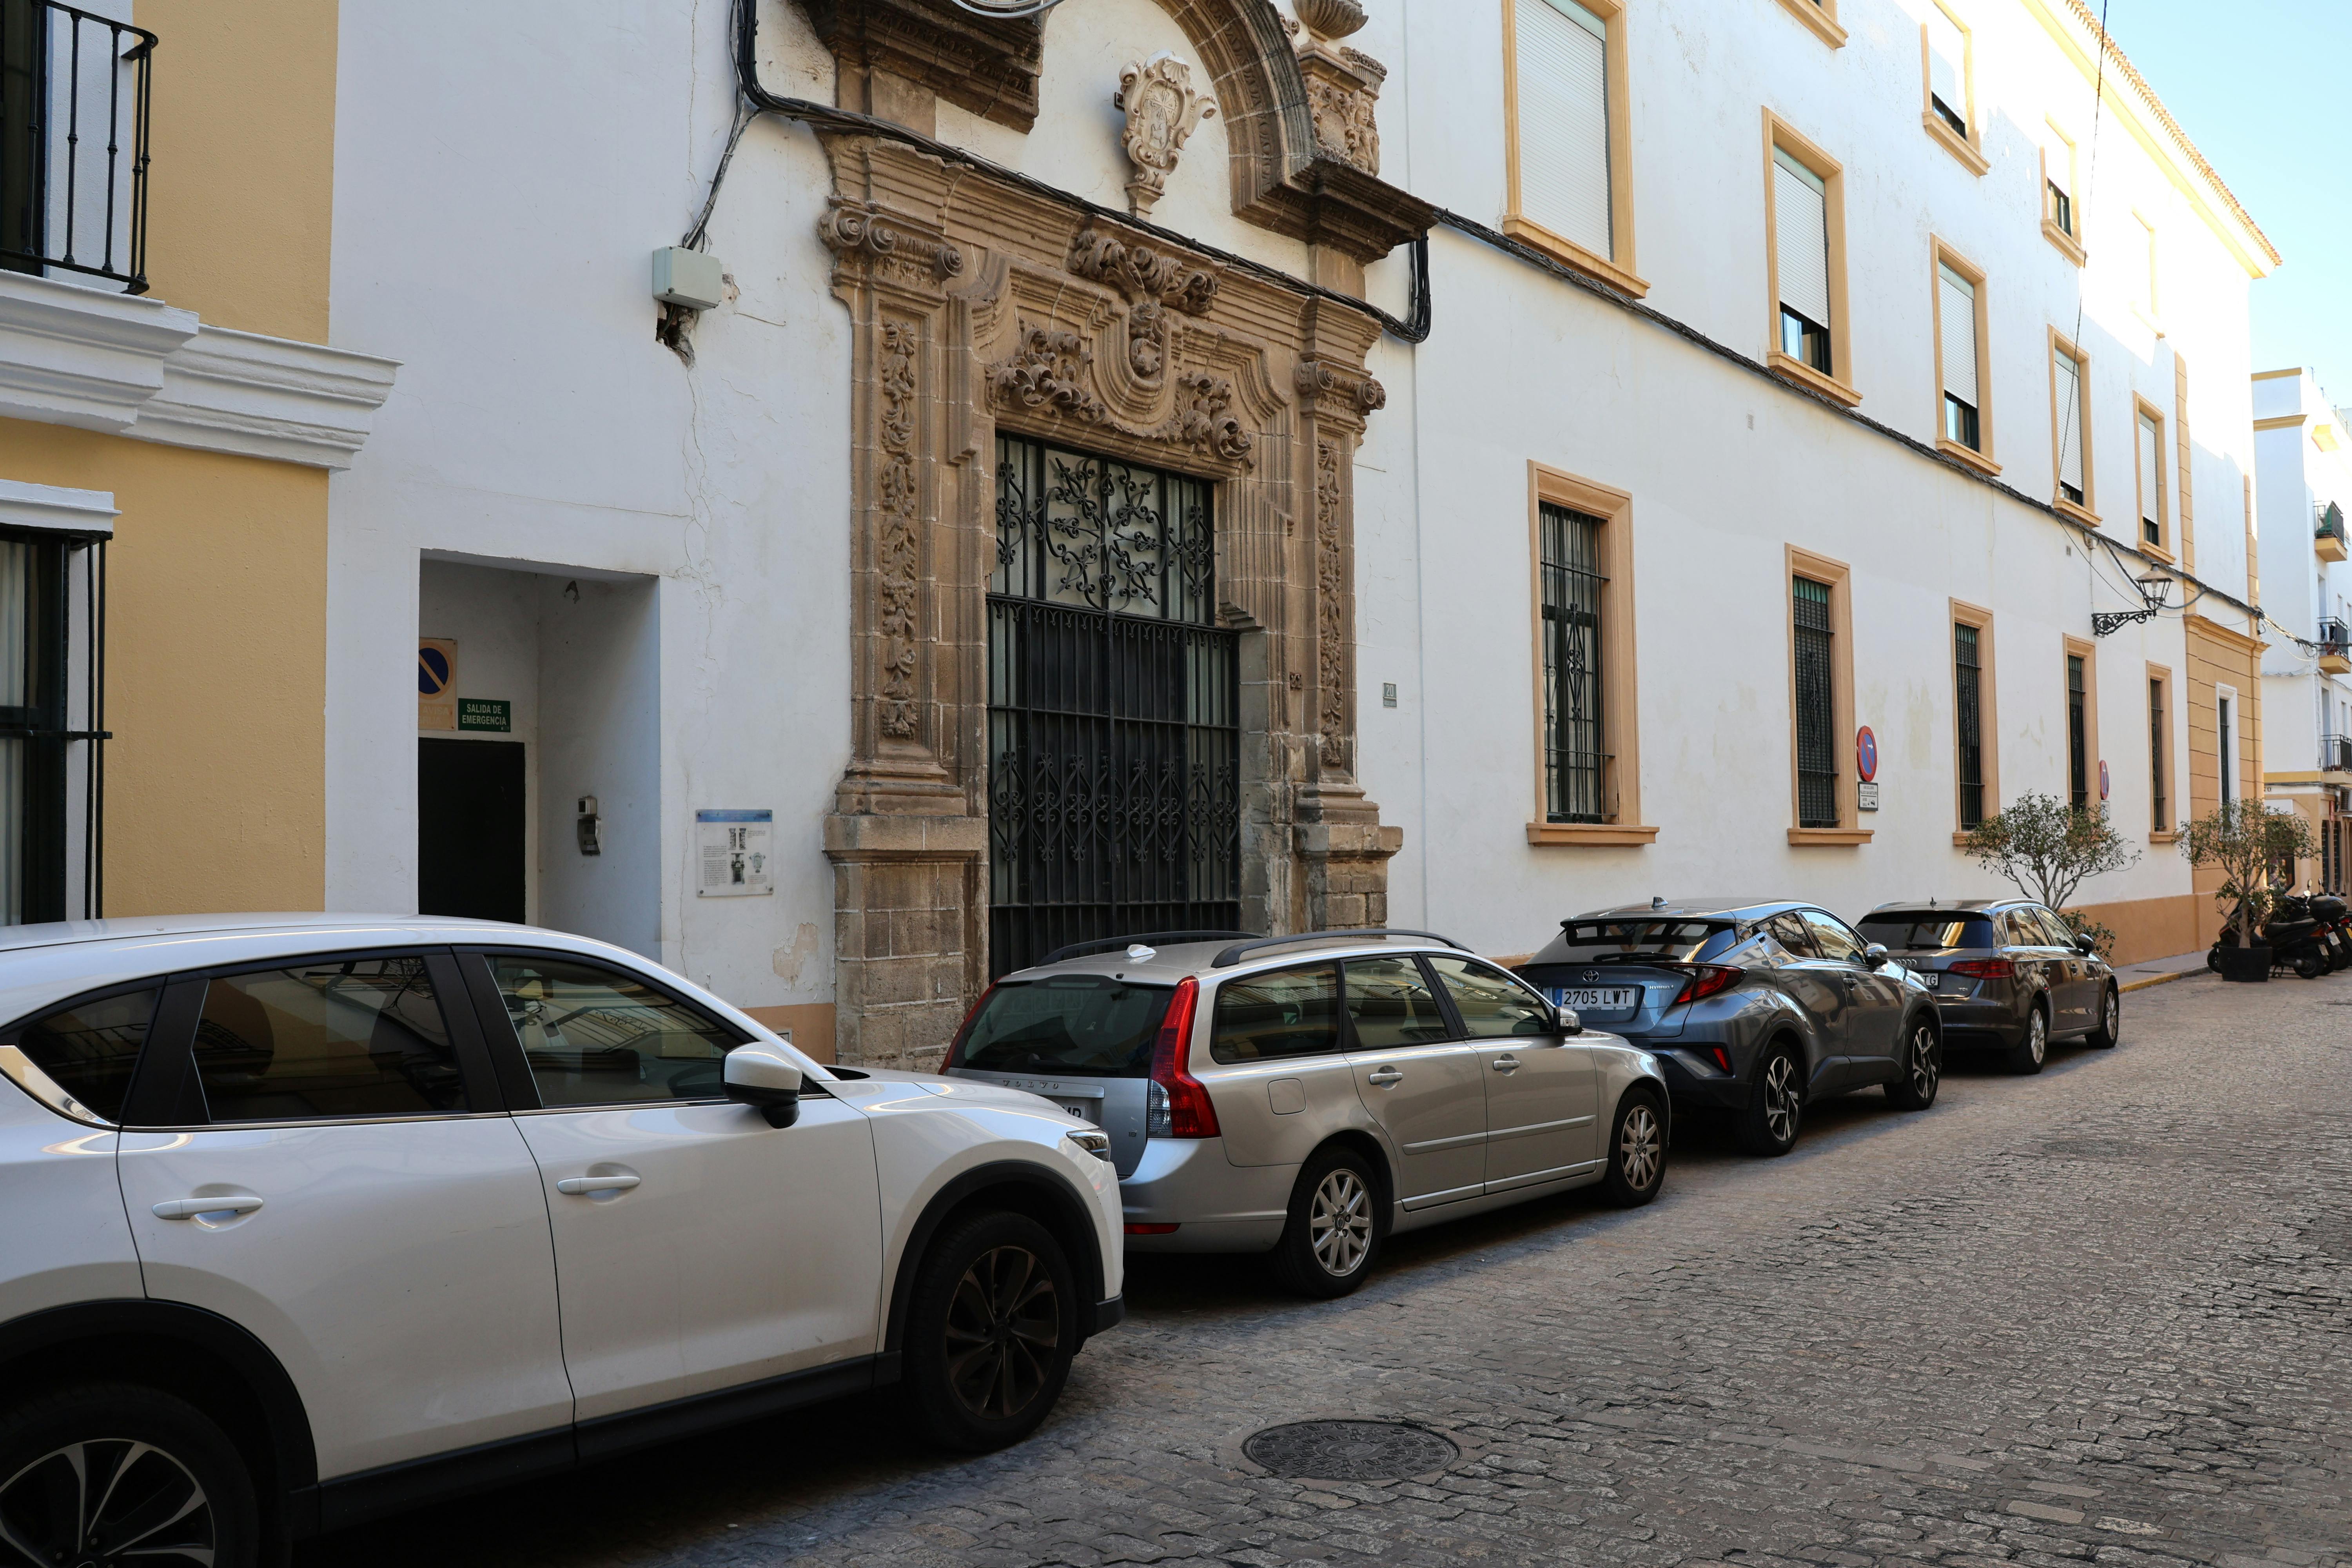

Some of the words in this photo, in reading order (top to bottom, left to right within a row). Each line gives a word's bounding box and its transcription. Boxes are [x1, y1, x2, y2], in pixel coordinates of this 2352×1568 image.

[1386, 684, 1394, 697] 20
[466, 704, 491, 713] SALIDA
[493, 705, 501, 714] DE
[462, 715, 506, 725] EMERGENCIA
[1564, 991, 1598, 1004] 2705
[1604, 990, 1630, 1004] LWT
[1003, 1080, 1059, 1089] VOLVO
